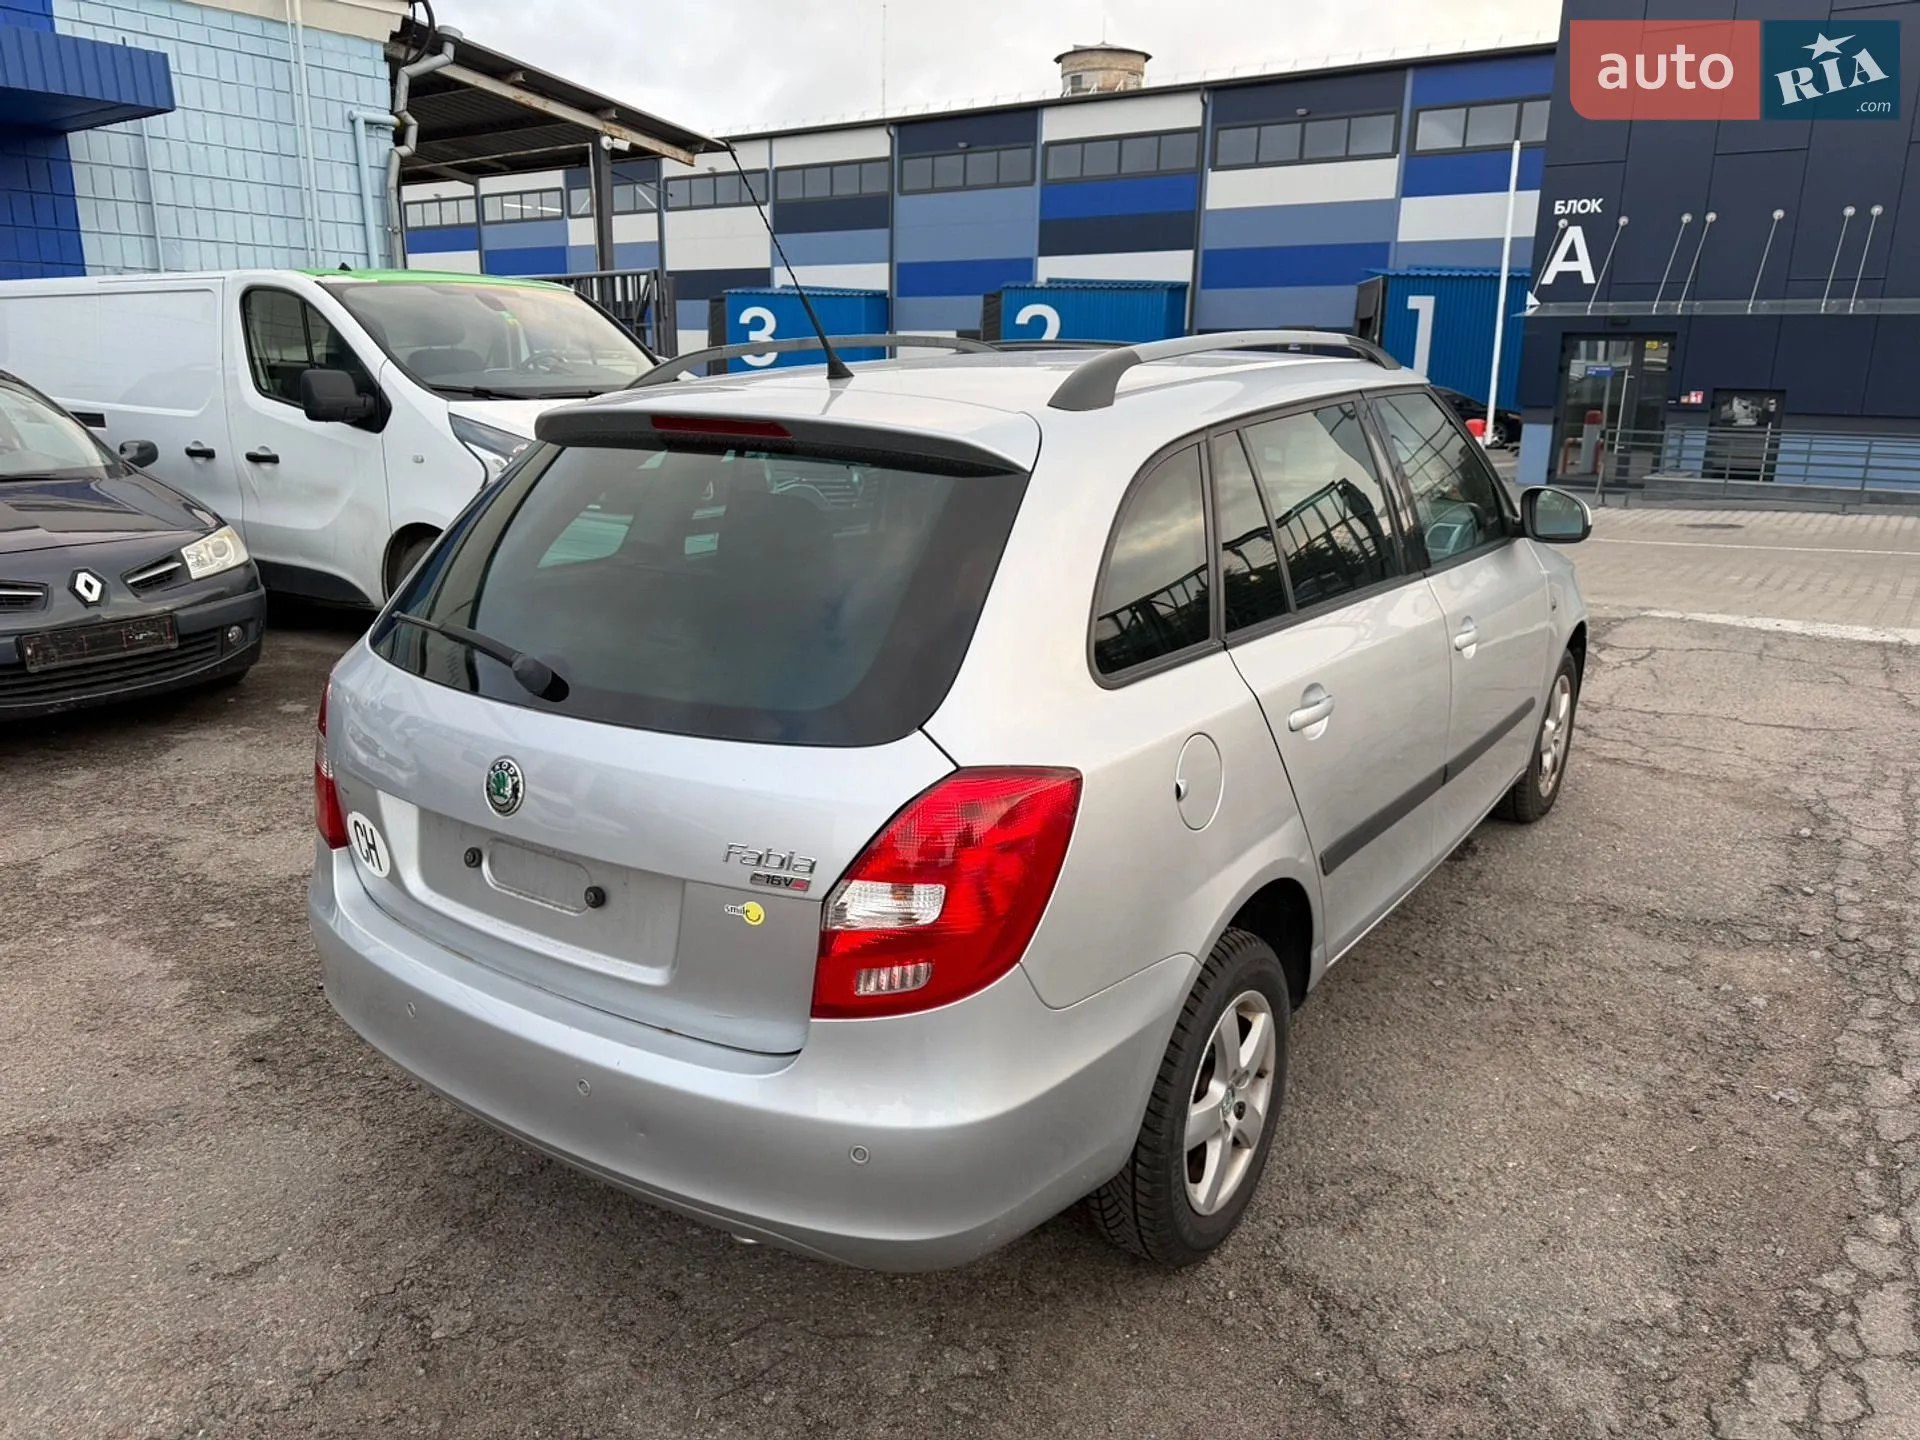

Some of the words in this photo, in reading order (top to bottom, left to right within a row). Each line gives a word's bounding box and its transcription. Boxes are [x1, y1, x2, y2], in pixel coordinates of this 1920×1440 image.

[1554, 198, 1604, 215] БЛОК
[1540, 225, 1596, 285] А
[739, 306, 778, 367] 3
[1015, 303, 1061, 341] 2
[1406, 295, 1435, 377] 1
[353, 820, 383, 872] CH
[723, 842, 817, 874] Fabia
